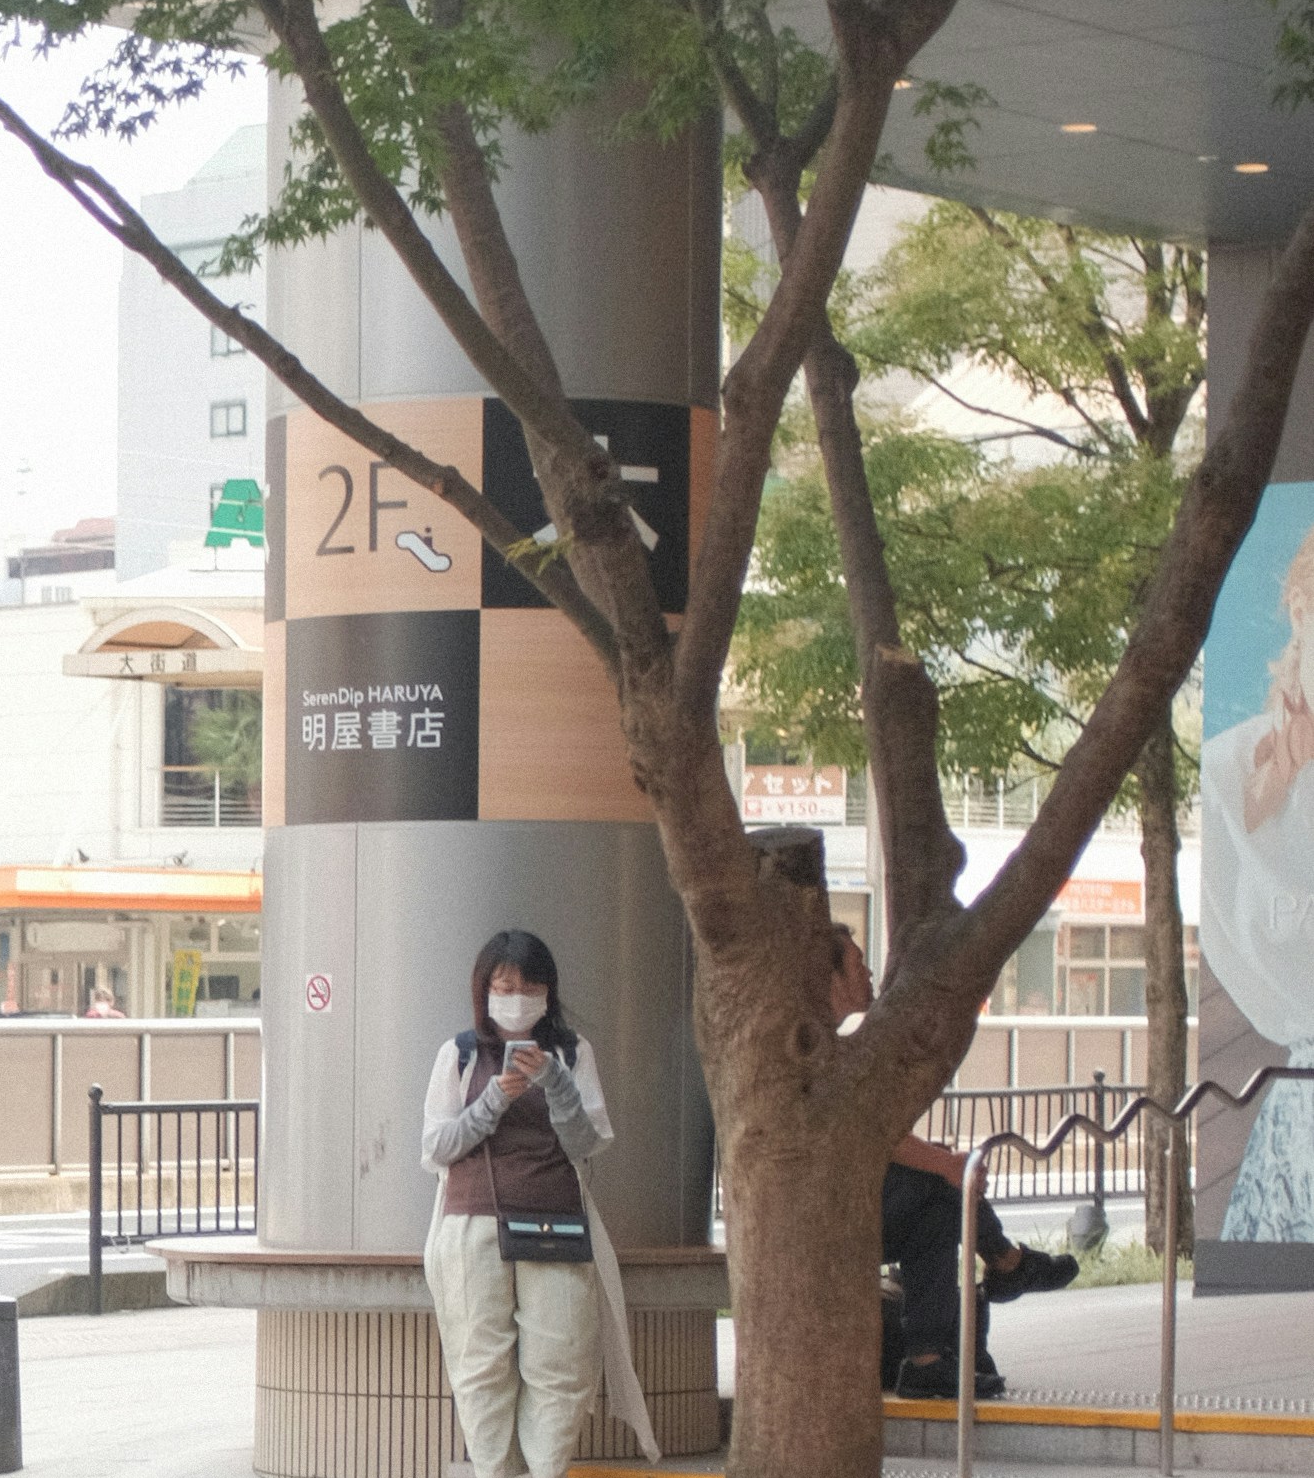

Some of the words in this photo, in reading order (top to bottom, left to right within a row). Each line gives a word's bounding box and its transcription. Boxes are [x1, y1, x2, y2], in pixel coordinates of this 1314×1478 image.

[316, 461, 408, 556] 2F
[119, 652, 198, 676] 大街道
[302, 687, 364, 709] SerenDip
[367, 684, 443, 703] HARUYA
[301, 707, 445, 751] 明屋書店
